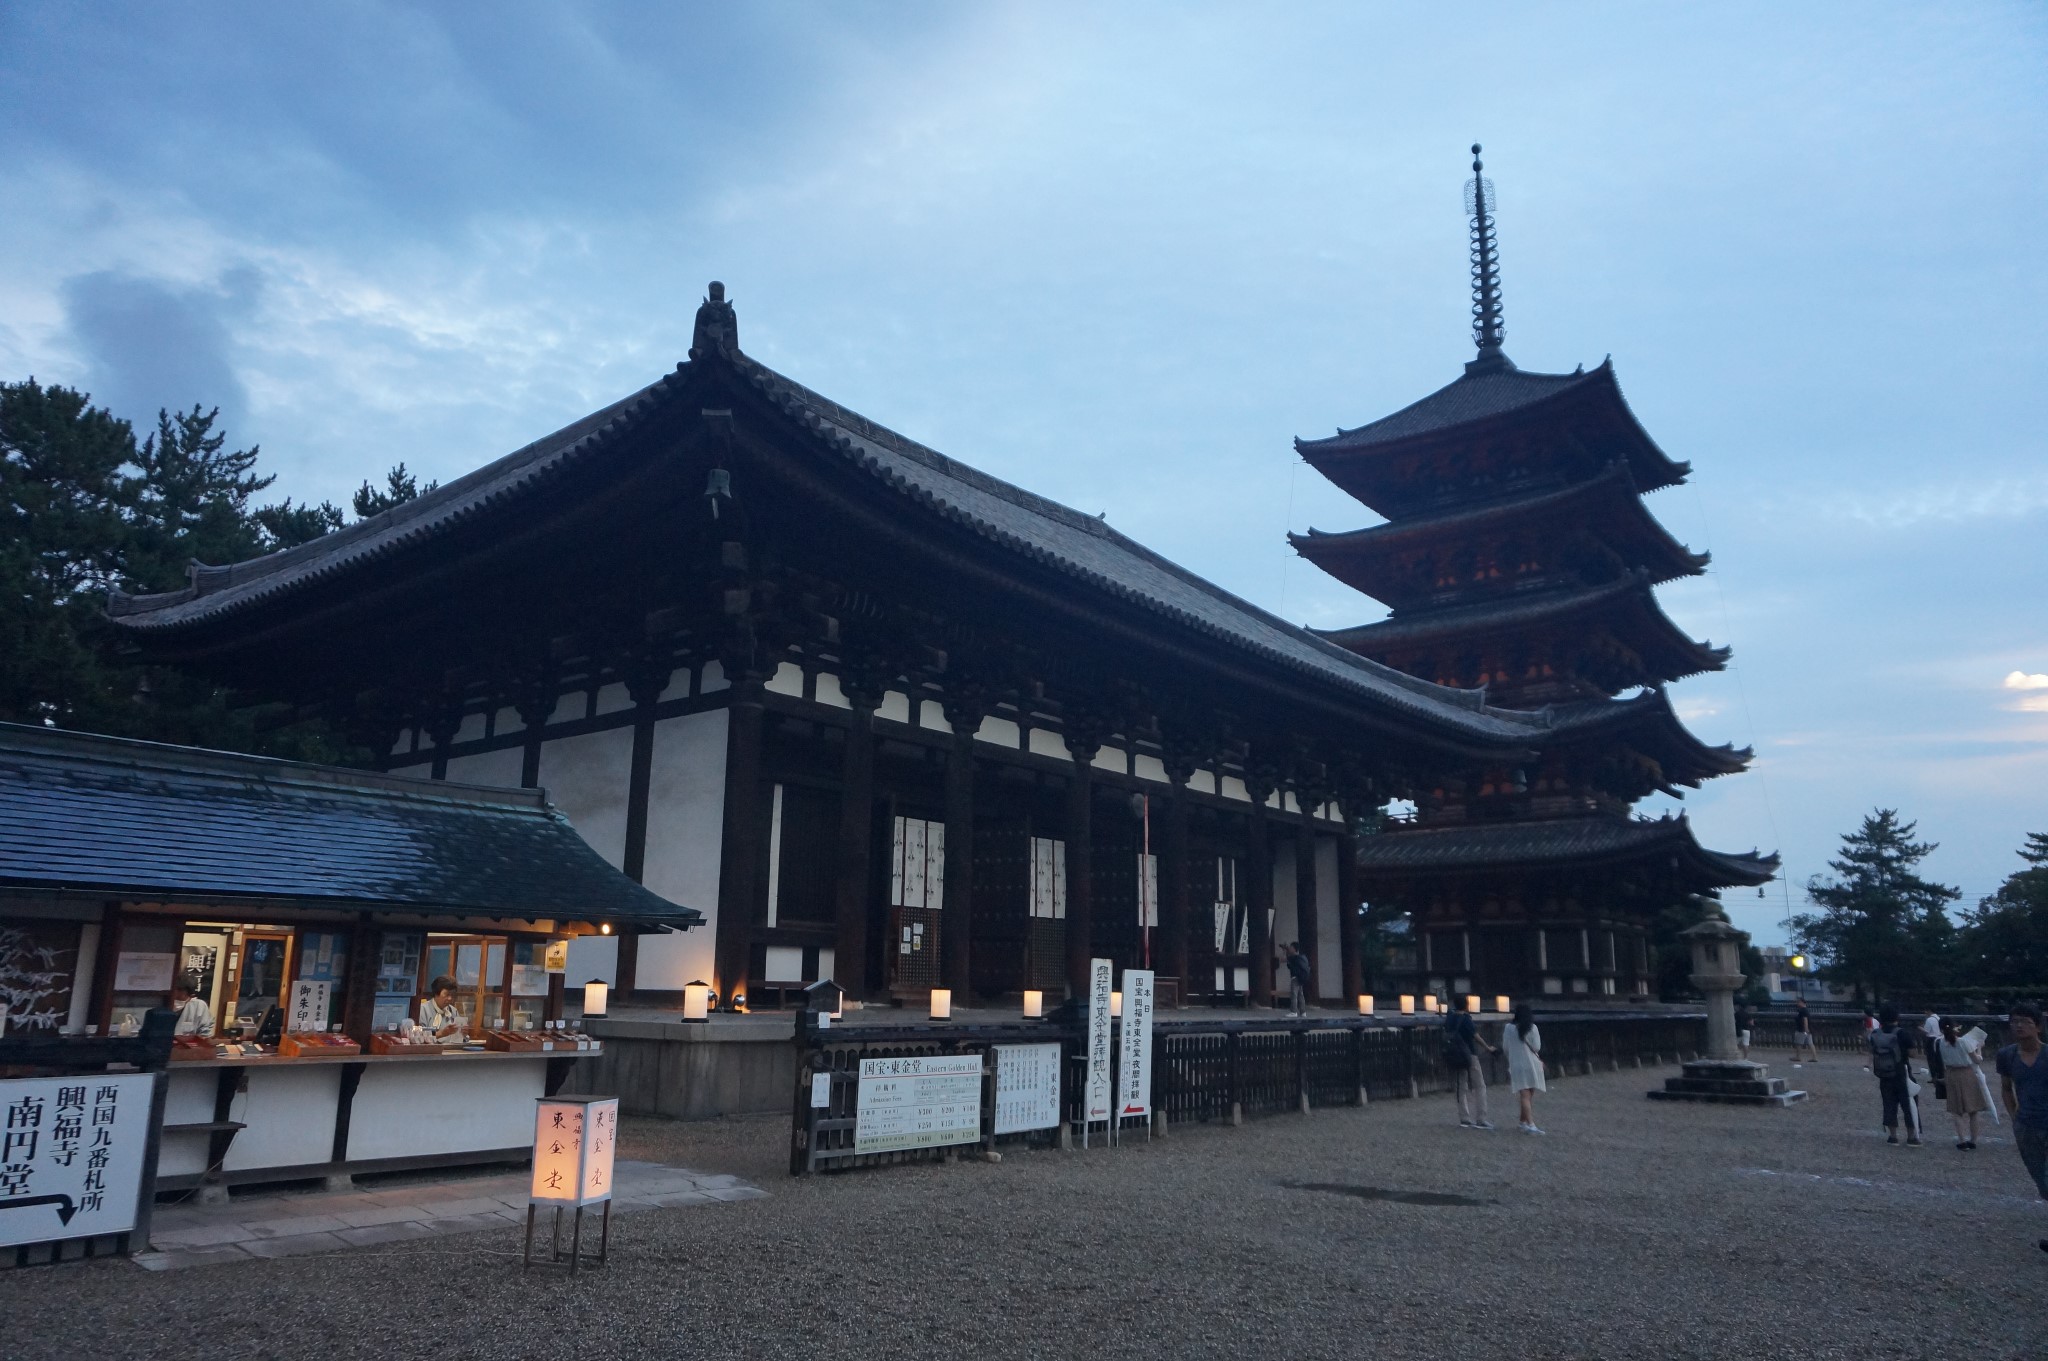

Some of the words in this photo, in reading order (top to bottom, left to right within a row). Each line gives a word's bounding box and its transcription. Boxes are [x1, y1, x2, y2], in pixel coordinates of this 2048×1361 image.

[1130, 977, 1144, 1100] 国宝興福寺東金堂夜間拝観
[1143, 988, 1152, 1013] 本日
[926, 1064, 947, 1073] Eastern
[948, 1063, 966, 1072] Golden
[967, 1063, 978, 1071] Hall
[0, 1096, 46, 1196] 南円堂
[49, 1086, 86, 1167] 興福寺
[78, 1084, 119, 1213] 西国九番札所
[543, 1112, 567, 1191] 東金堂
[572, 1112, 584, 1150] 興福寺
[590, 1111, 604, 1188] 東金堂
